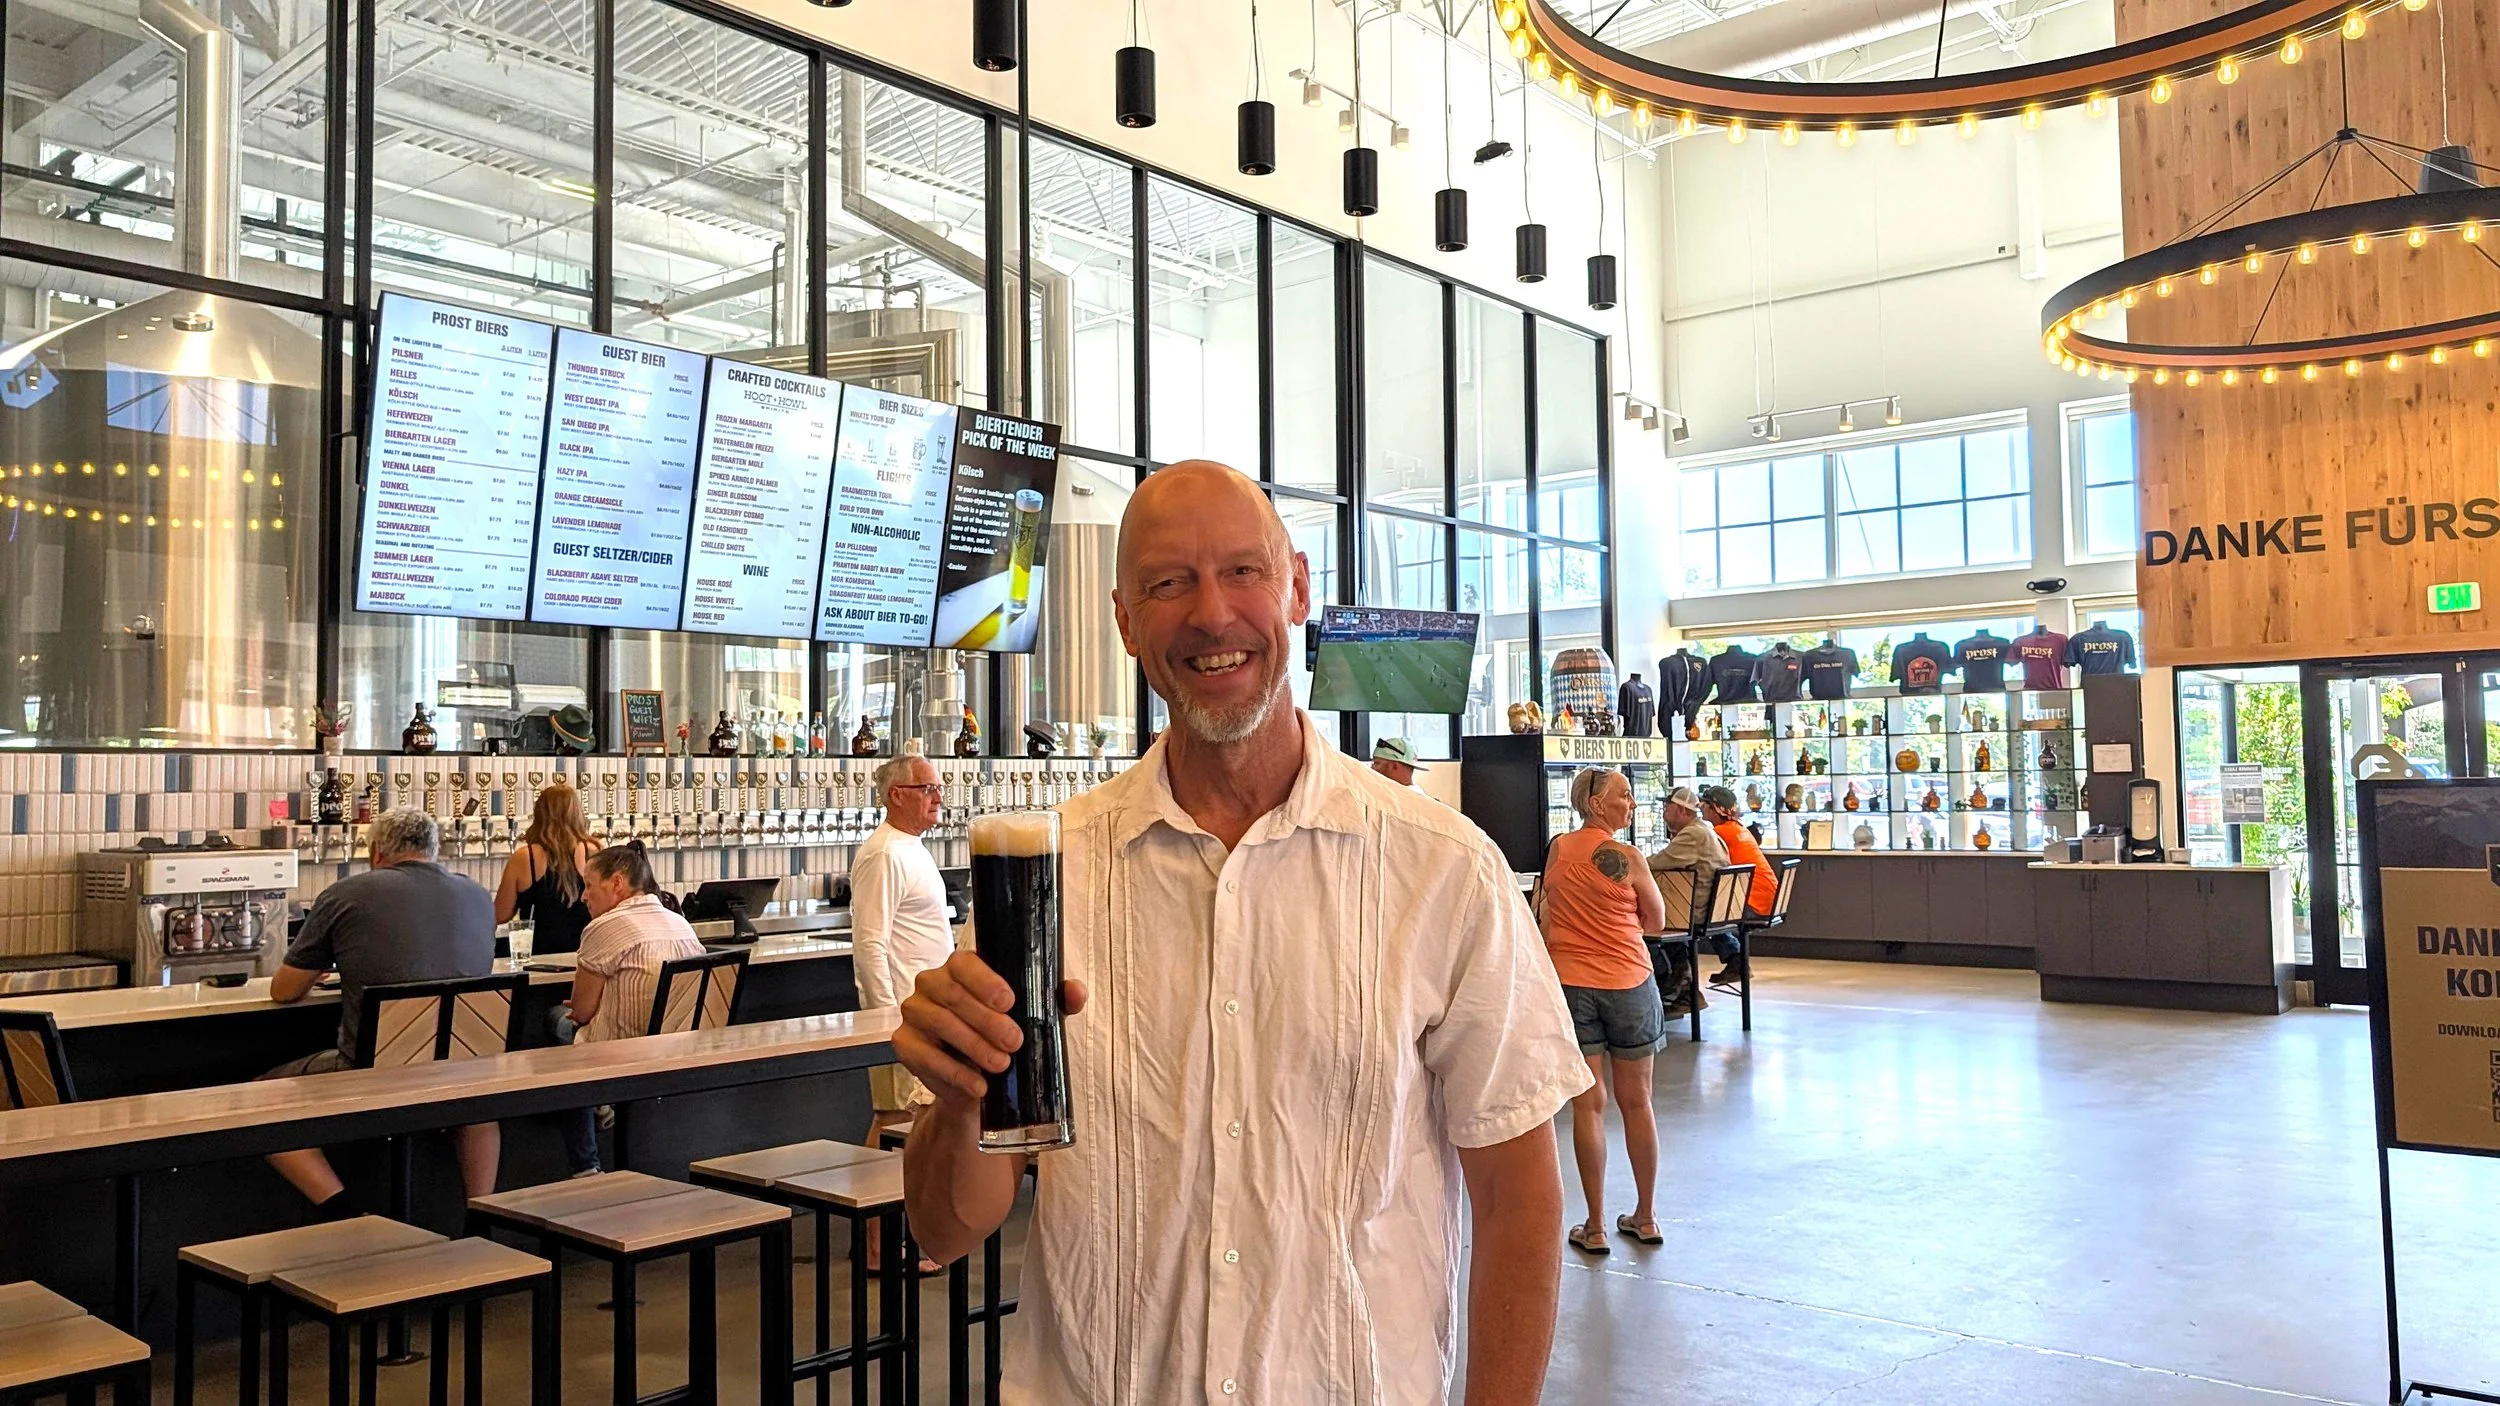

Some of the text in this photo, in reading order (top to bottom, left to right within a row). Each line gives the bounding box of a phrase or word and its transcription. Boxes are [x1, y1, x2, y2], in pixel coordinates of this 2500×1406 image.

[432, 312, 509, 337] PROST BIERS
[412, 339, 431, 348] LIGHTER
[392, 348, 423, 360] PILSNER
[602, 345, 666, 368] GUEST BIER
[390, 368, 417, 379] HELLES
[568, 362, 625, 379] THUNDER STRUCK
[728, 369, 826, 398] CRAFTED COCKTAILS
[389, 388, 418, 400] KÖLSCH
[744, 390, 807, 409] HOOT HOWL
[565, 393, 619, 409] WEST COAST IPA
[880, 399, 924, 417] BIER SIZES
[386, 409, 433, 422] HEFEWEIZEN
[716, 414, 773, 429] FROZEN MARGARITA
[871, 414, 884, 422] YOUR
[562, 418, 609, 432] SAN DIEGO IPA
[975, 414, 1043, 441] BIERTENDER
[385, 429, 456, 446] BIERGARTEN LAGER
[559, 443, 594, 454] BLACK IPA
[713, 437, 754, 449] WATERMELON
[755, 442, 775, 453] FREEZE
[962, 430, 1056, 460] PICK OF THE WEEK
[712, 454, 747, 466] BIERGARTEN
[382, 460, 435, 474] VIENNA LAGER
[557, 467, 588, 478] HAZY IPA
[958, 465, 984, 478] Kölsch
[709, 472, 730, 480] SPIKED
[732, 475, 754, 484] ARNOLD
[756, 479, 778, 487] PALMER
[877, 470, 912, 484] FLIGHTS
[380, 480, 409, 491] DUNKEL
[842, 486, 877, 497] BRAUMEISTER
[554, 492, 623, 507] ORANGE CREAMSICLE
[707, 489, 757, 501] GINGER BLOSSOM
[955, 495, 985, 505] German-style
[378, 500, 435, 513] DUNKELWEIZEN
[705, 506, 764, 519] BLACKBERRY COSMO
[839, 504, 855, 512] BUILD
[856, 506, 870, 514] YOUR
[376, 521, 430, 533] SCHWARZBIER
[552, 516, 585, 526] LAVENDER
[587, 519, 622, 531] LEMONADE
[716, 525, 748, 535] FASHIONED
[851, 522, 920, 541] NON-ALCOHOLIC
[2145, 496, 2500, 567] DANKE FÜRS
[701, 541, 724, 550] CHILLED
[847, 544, 877, 552] PELLEGRINO
[374, 551, 433, 563] SUMMER LAGER
[554, 542, 673, 565] GUEST SELTZER/CIDER
[743, 564, 769, 577] WINE
[833, 561, 859, 569] PHANTOM
[860, 564, 878, 572] RABBIT
[890, 567, 905, 575] BREW
[372, 571, 434, 583] KRISTALLWEIZEN
[547, 569, 589, 579] BLACKBERRY
[591, 572, 611, 581] AGAVE
[613, 574, 638, 583] SELTZER
[845, 577, 875, 585] KOMBUCHA
[697, 578, 733, 588] HOUSE ROSÉ
[370, 591, 405, 600] MAIBOCK
[544, 592, 622, 605] COLORADO PEACH CIDER
[695, 595, 714, 603] HOUSE
[829, 590, 915, 604] DRAGONFRUIT MANGO LEMONADE
[2435, 583, 2473, 611] EXIT
[693, 612, 712, 620] HOUSE
[824, 607, 928, 625] ASK ABOUT BIER TO-GO!
[1966, 648, 1998, 660] prost
[2022, 646, 2052, 659] prost
[2084, 642, 2118, 653] prost
[627, 694, 659, 706] PROST
[630, 705, 652, 715] GUEST
[1574, 740, 1639, 759] BIERS TO GO
[321, 802, 343, 813] pro
[2447, 968, 2500, 998] KO
[2438, 1024, 2500, 1038] DOWNLO
